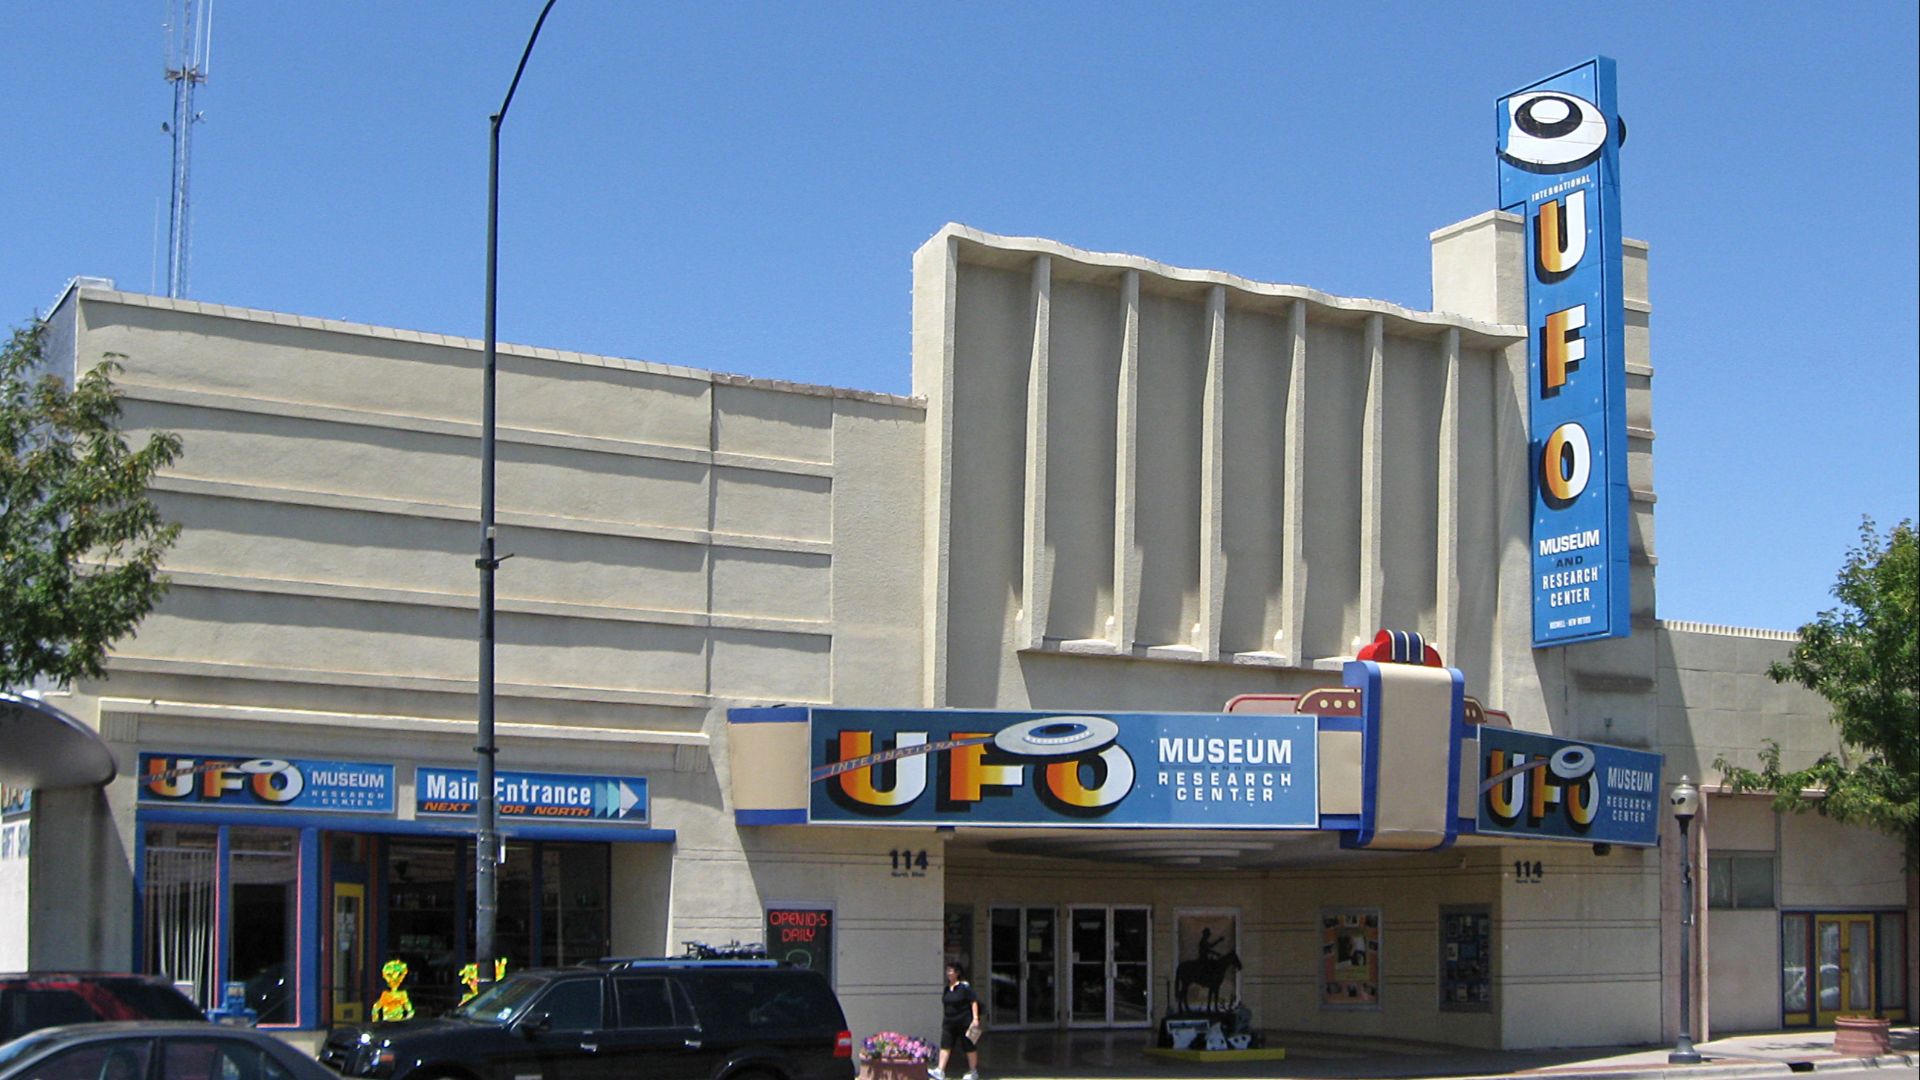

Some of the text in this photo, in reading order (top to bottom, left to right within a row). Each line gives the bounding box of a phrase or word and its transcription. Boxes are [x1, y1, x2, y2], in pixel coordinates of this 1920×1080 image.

[1531, 174, 1591, 202] INTERNATIONAL
[1539, 529, 1600, 556] MUSEUM
[1556, 555, 1584, 568] AND
[1542, 566, 1599, 590] RESEARCH
[1550, 587, 1590, 608] CENTER
[829, 740, 965, 774] INTERNATIONAL
[1158, 738, 1292, 764] MUSEUM
[840, 730, 1135, 807] UFO
[149, 758, 304, 802] UFO
[311, 770, 385, 788] MUSEUM
[1158, 772, 1292, 786] RESEARCH
[1490, 751, 1600, 825] UFO
[1607, 766, 1654, 793] MUSEUM
[311, 790, 384, 799] RESEARCH
[426, 774, 591, 805] Main Entrance
[1176, 787, 1273, 801] CENTER
[322, 798, 373, 807] CENTER
[424, 802, 471, 812] NEXT
[533, 807, 591, 817] NORTH
[1606, 795, 1652, 811] RESEARCH
[1612, 809, 1646, 824] CENTER
[889, 849, 929, 871] 114
[1514, 860, 1544, 878] 114
[769, 911, 804, 927] OPEN
[782, 928, 816, 943] DAILY
